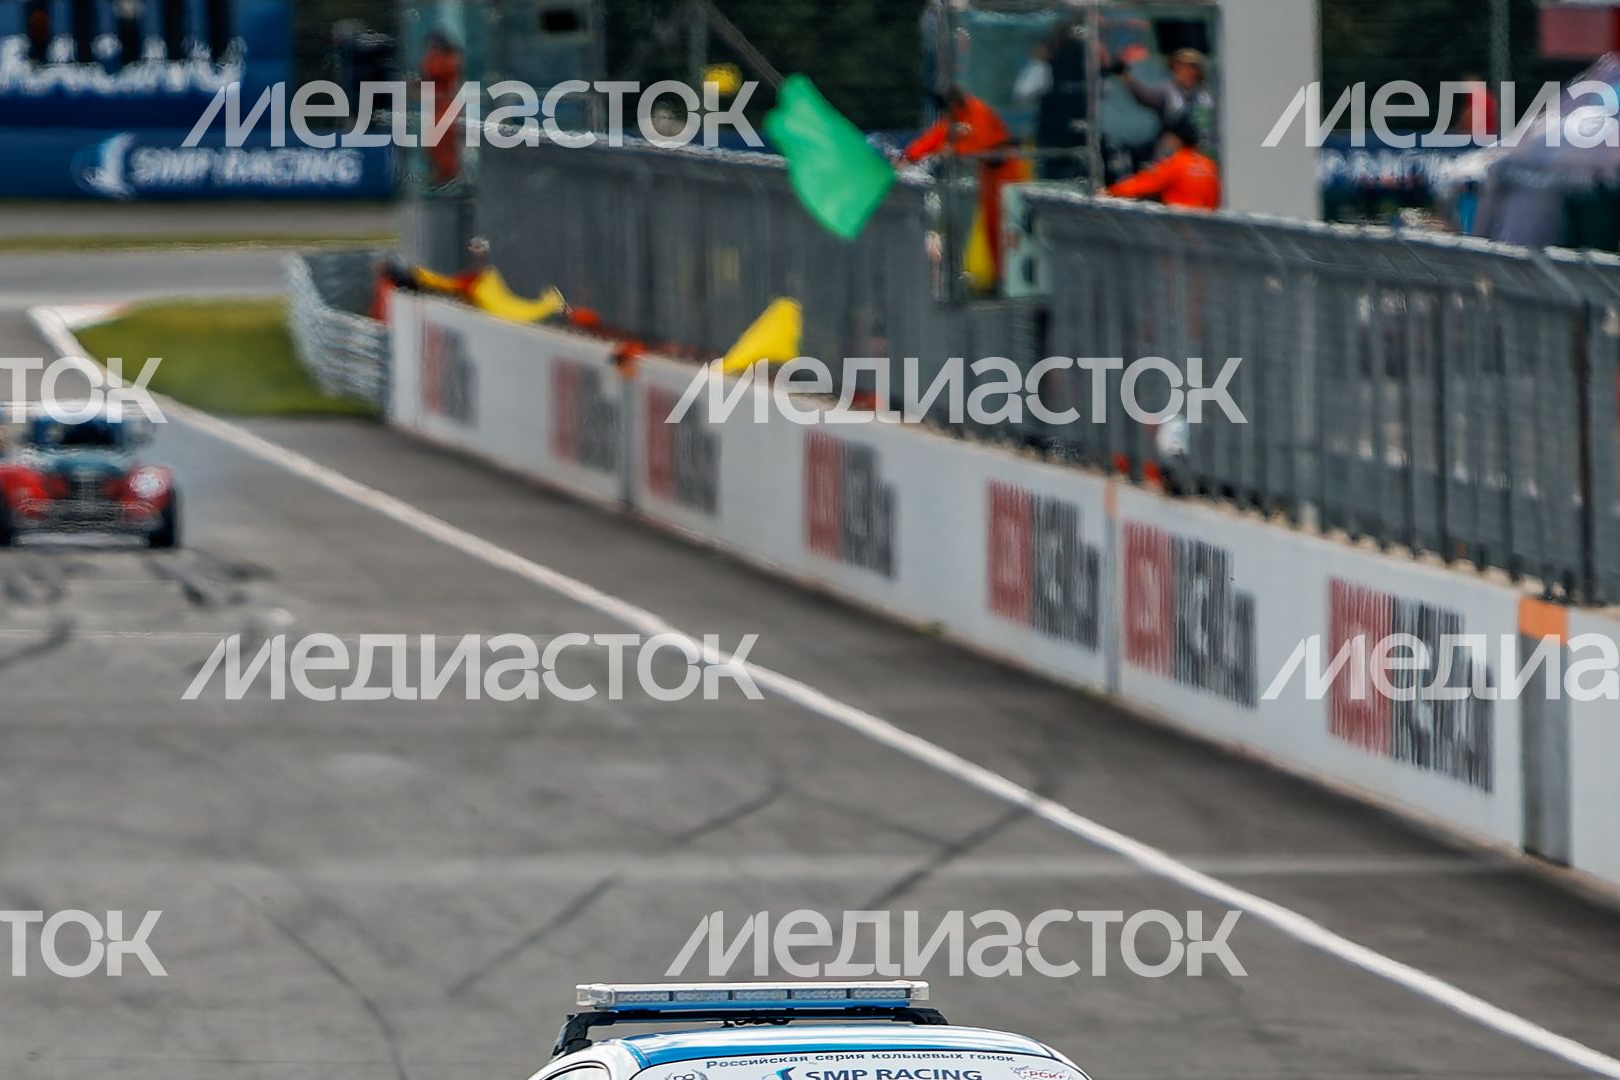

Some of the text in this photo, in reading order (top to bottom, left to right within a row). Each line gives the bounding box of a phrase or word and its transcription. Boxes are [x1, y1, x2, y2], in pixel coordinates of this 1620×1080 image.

[706, 1052, 1016, 1069] Российская серия кольцевых гонок
